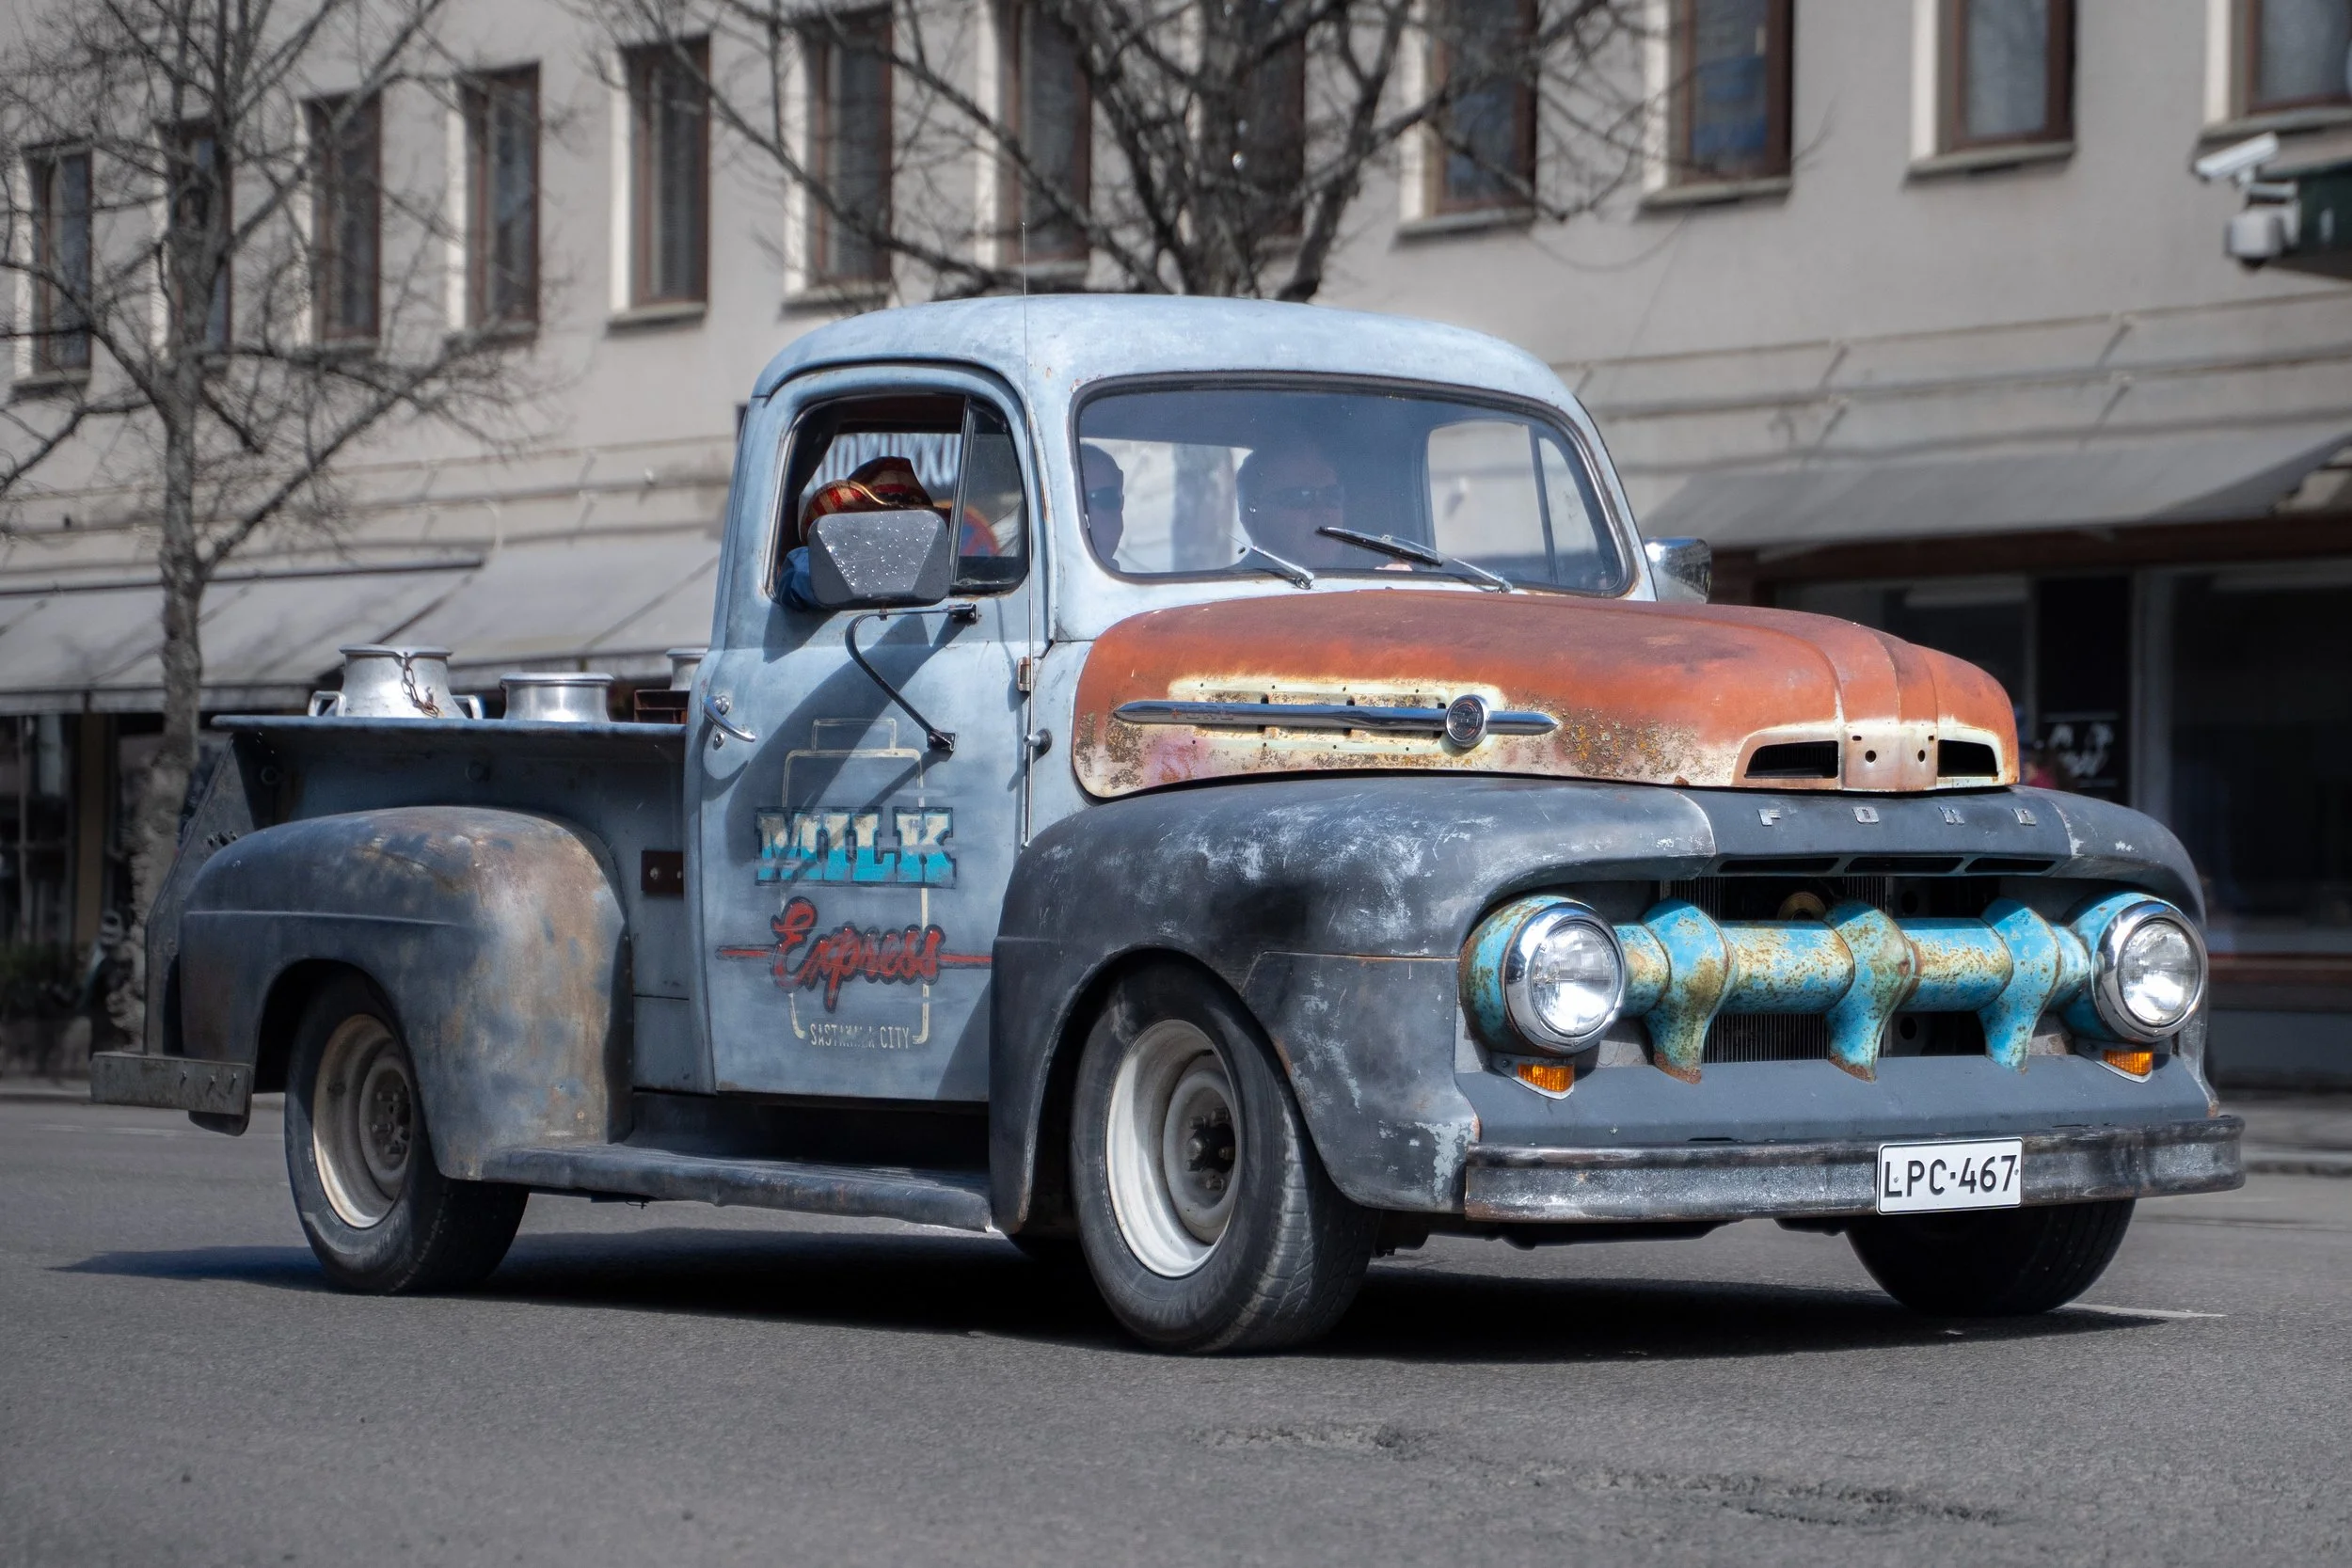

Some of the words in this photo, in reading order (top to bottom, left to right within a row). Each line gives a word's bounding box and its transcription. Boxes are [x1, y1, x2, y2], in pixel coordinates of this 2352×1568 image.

[1757, 805, 2037, 826] FORD
[755, 807, 956, 888] MILK
[771, 896, 946, 1013] Express
[880, 1025, 910, 1049] CITY
[1884, 1154, 2017, 1198] LPC-467
